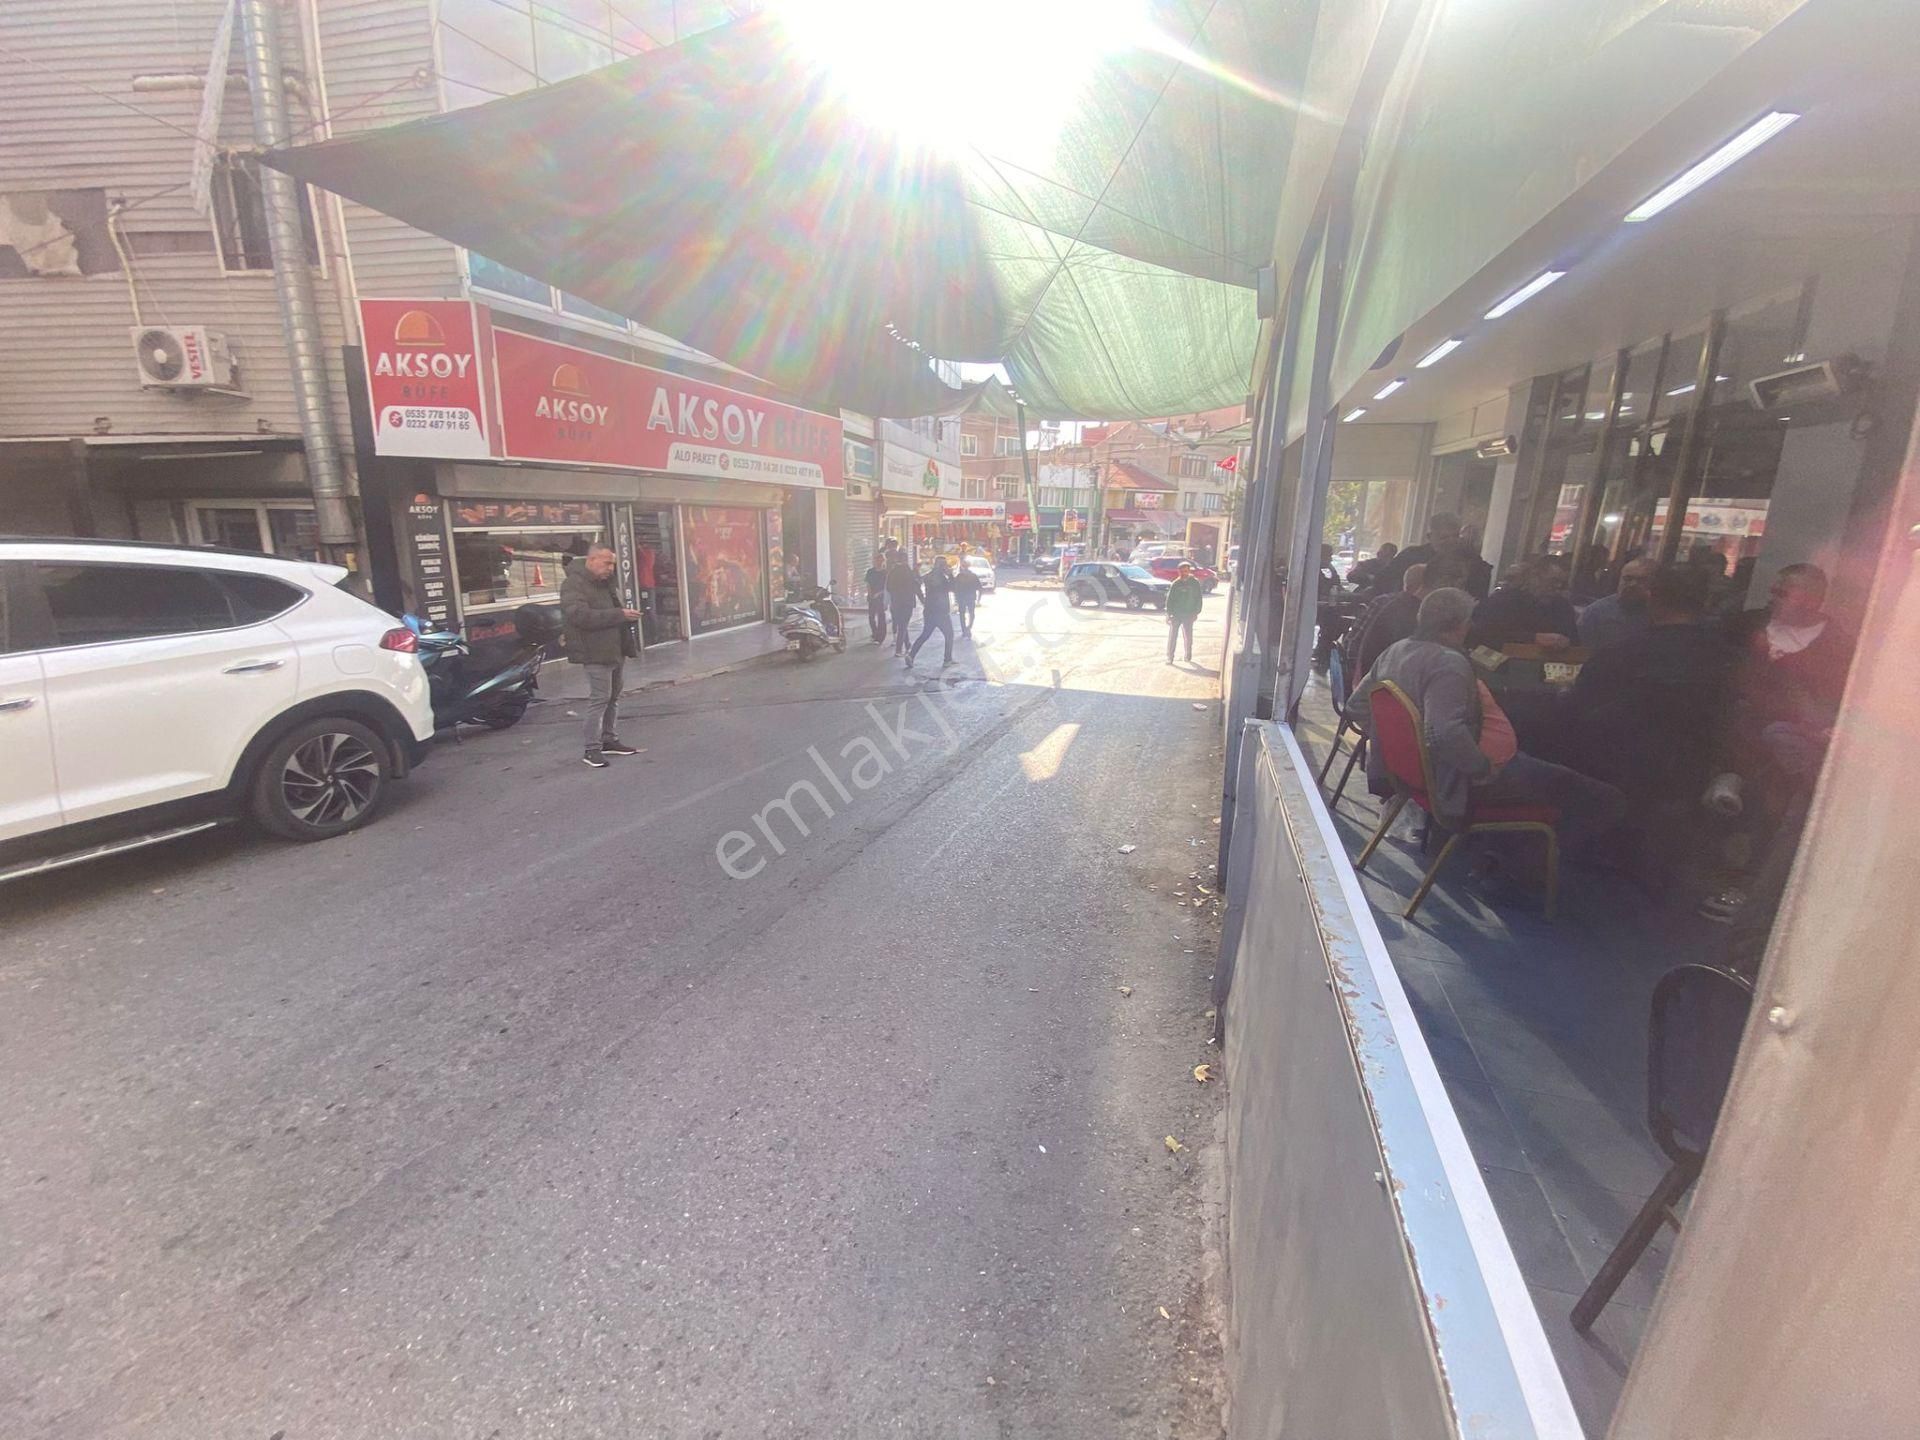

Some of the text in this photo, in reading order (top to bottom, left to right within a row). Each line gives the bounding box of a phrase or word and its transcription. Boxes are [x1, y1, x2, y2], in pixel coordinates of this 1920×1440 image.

[183, 332, 202, 380] VESTEL
[374, 352, 472, 378] AKSOY
[403, 382, 449, 398] BÜFE
[405, 409, 469, 420] 0535 778 14 30
[535, 396, 608, 426] AKSOY
[406, 420, 470, 430] 0232 487 91 65
[647, 387, 830, 458] AKSOY BÜFE
[674, 449, 690, 462] ALO
[692, 451, 718, 465] PAKET
[408, 505, 439, 513] AKSOY
[620, 521, 631, 583] AKSOY
